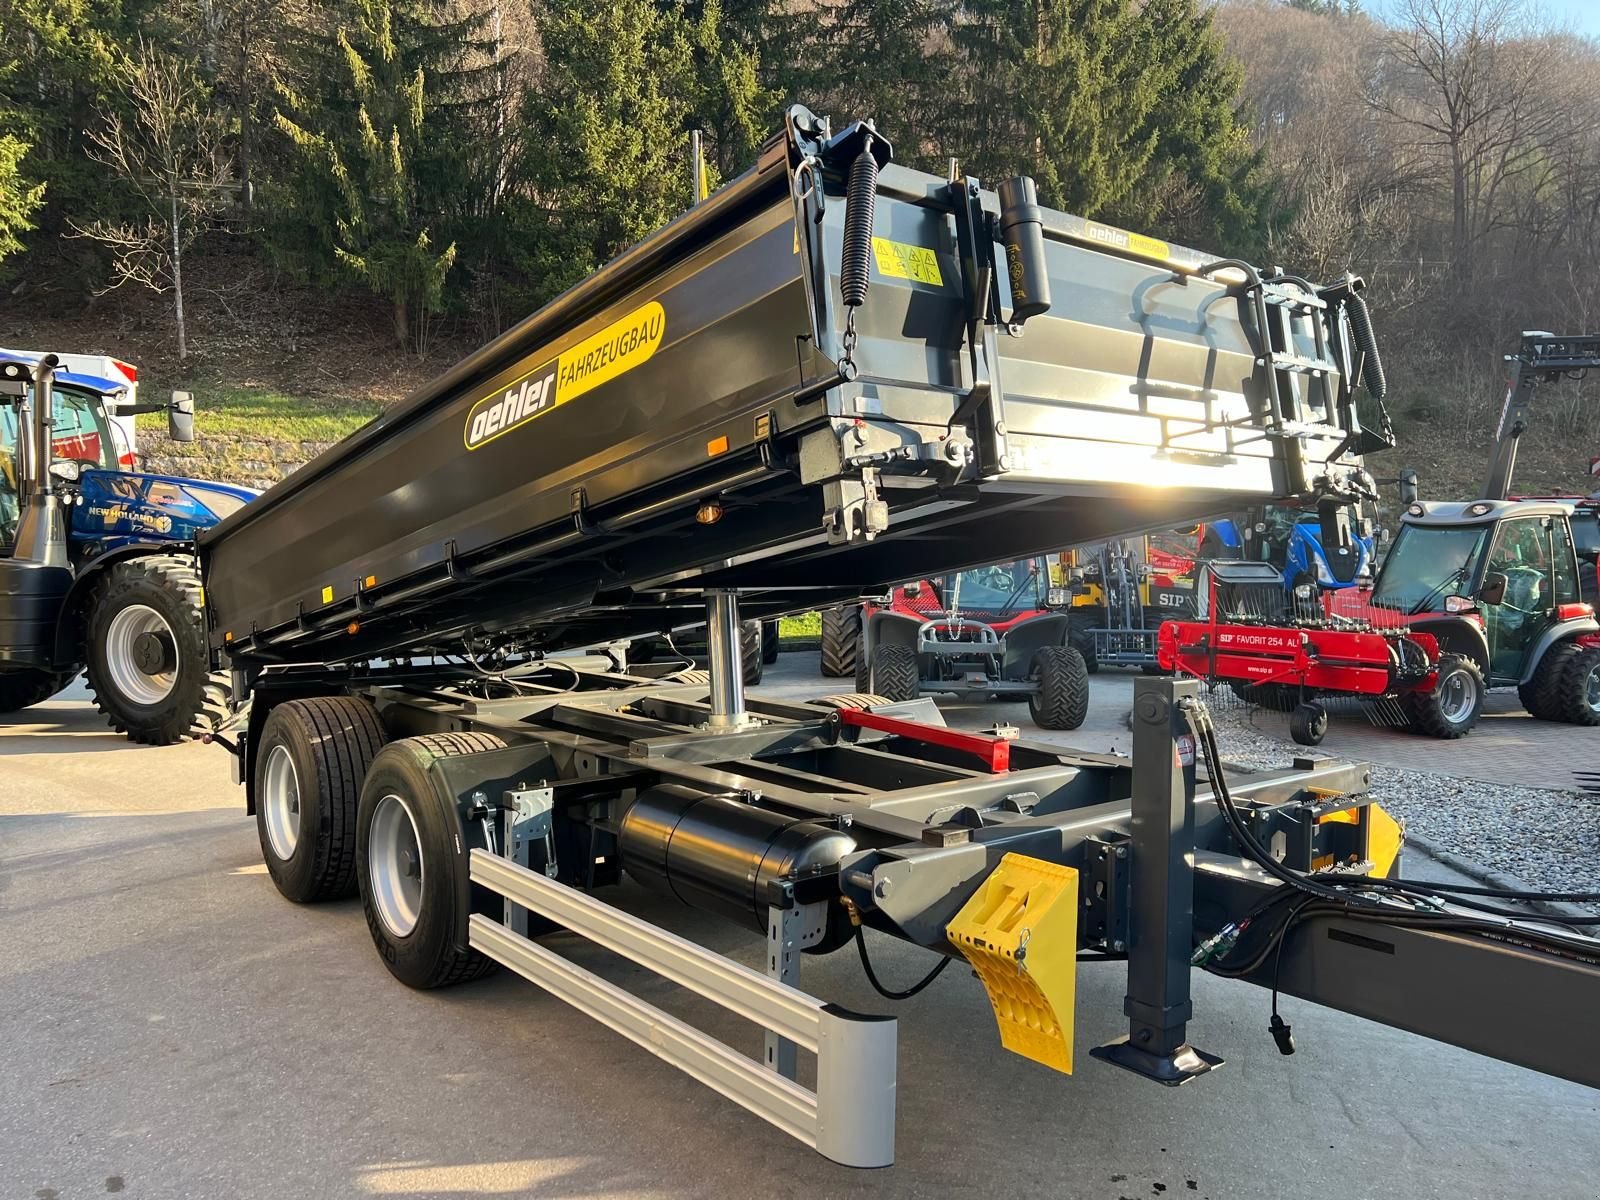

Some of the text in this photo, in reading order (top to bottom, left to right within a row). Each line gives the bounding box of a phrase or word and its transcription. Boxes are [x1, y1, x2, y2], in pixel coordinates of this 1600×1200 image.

[1089, 226, 1128, 248] oehler
[470, 313, 662, 444] oehler FAHRZEUGBAU
[88, 506, 154, 523] NEW HOLLAND
[1159, 593, 1184, 607] SIP
[1220, 634, 1233, 642] SIP
[1236, 635, 1267, 645] FAVORIT
[1267, 637, 1283, 646] 254
